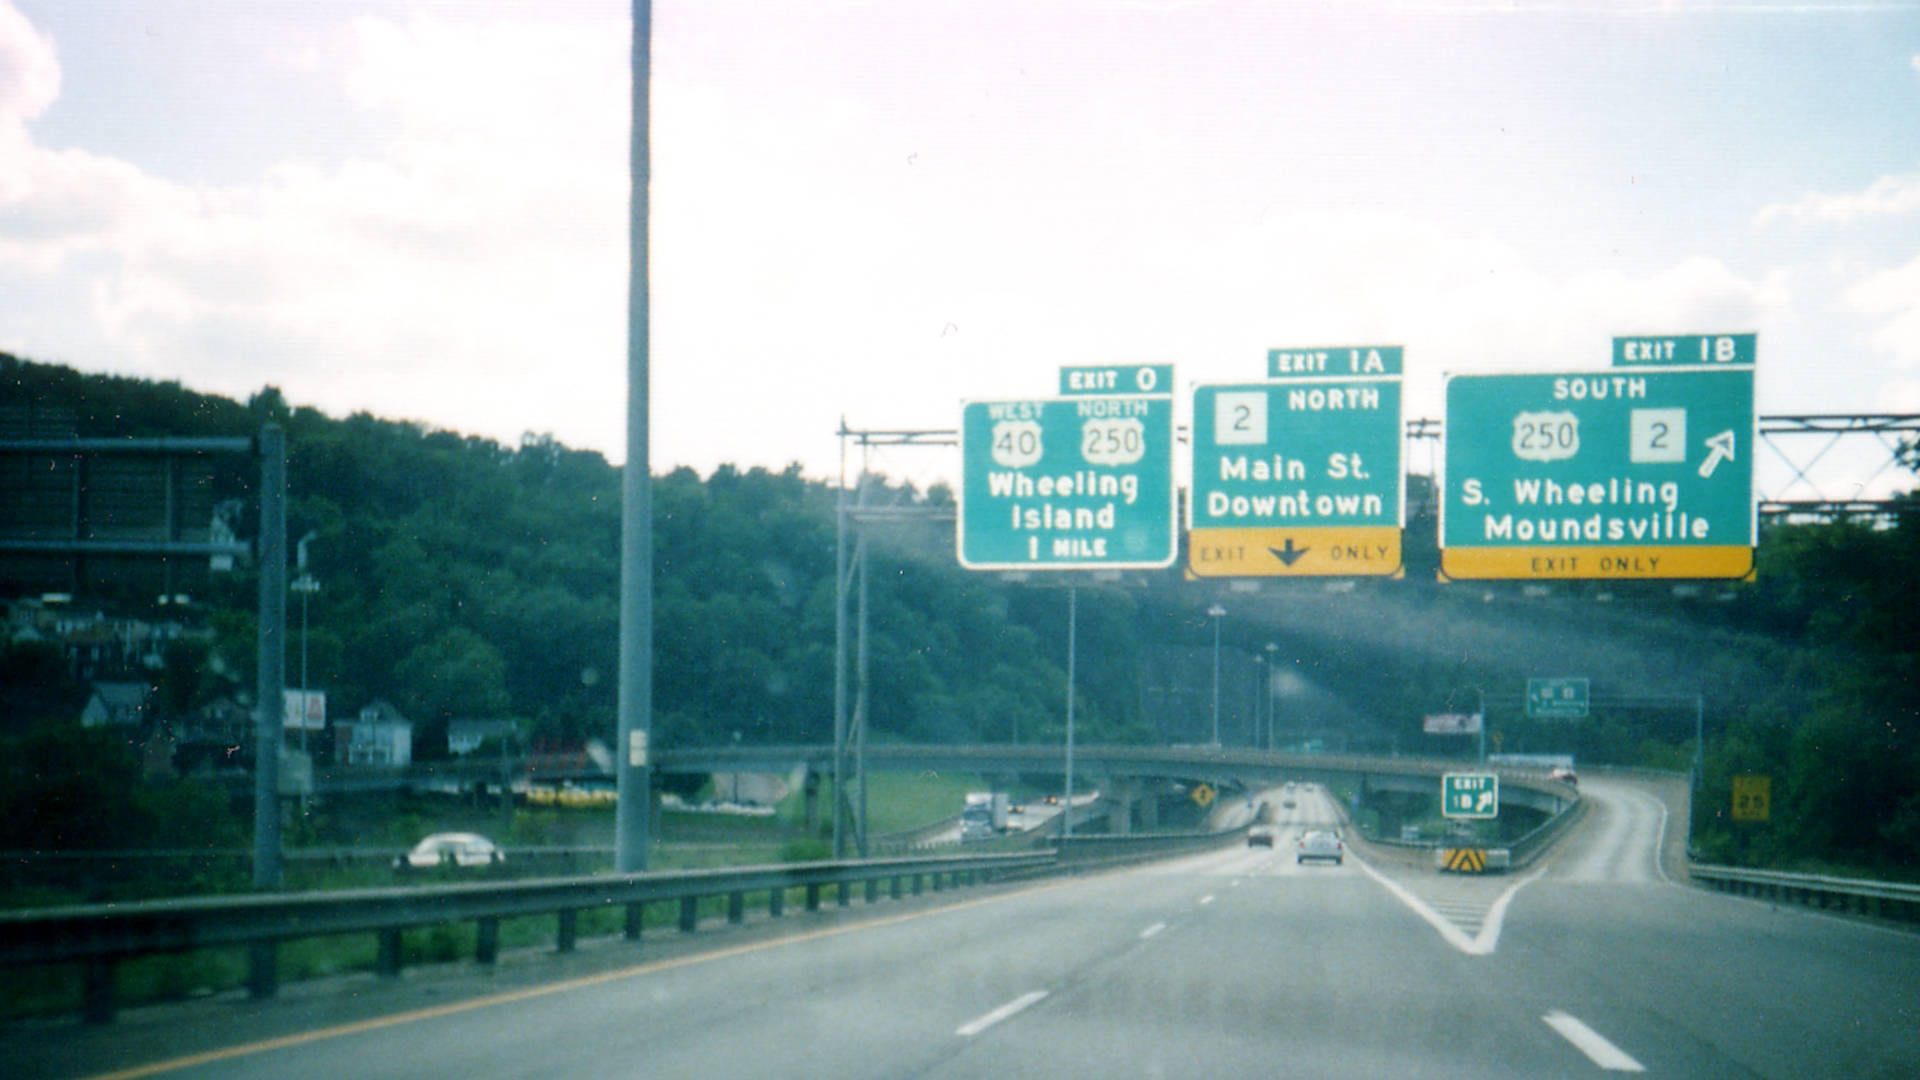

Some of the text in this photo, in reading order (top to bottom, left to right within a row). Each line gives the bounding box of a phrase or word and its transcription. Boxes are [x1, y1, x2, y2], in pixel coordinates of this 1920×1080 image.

[1278, 349, 1385, 373] EXIT 1A
[1624, 337, 1736, 362] EXIT 1B
[1068, 371, 1118, 390] EXIT
[1553, 377, 1647, 399] SOUTH
[988, 400, 1149, 420] WEST NORTH
[1289, 388, 1379, 411] NORTH
[1233, 404, 1251, 431] 2
[996, 428, 1140, 455] 40 250
[1520, 422, 1669, 450] 250 2
[1220, 453, 1370, 481] Main St.
[988, 471, 1138, 505] Wheeling
[1462, 477, 1679, 511] S. Wheeling
[1207, 490, 1382, 517] Downtown
[1012, 503, 1115, 530] Island
[1484, 512, 1710, 540] Moundsville
[1029, 535, 1107, 560] 1 MILE
[1201, 545, 1389, 562] EXIT ONLY
[1531, 557, 1660, 572] EXIT ONLY
[1454, 778, 1486, 791] EXIT
